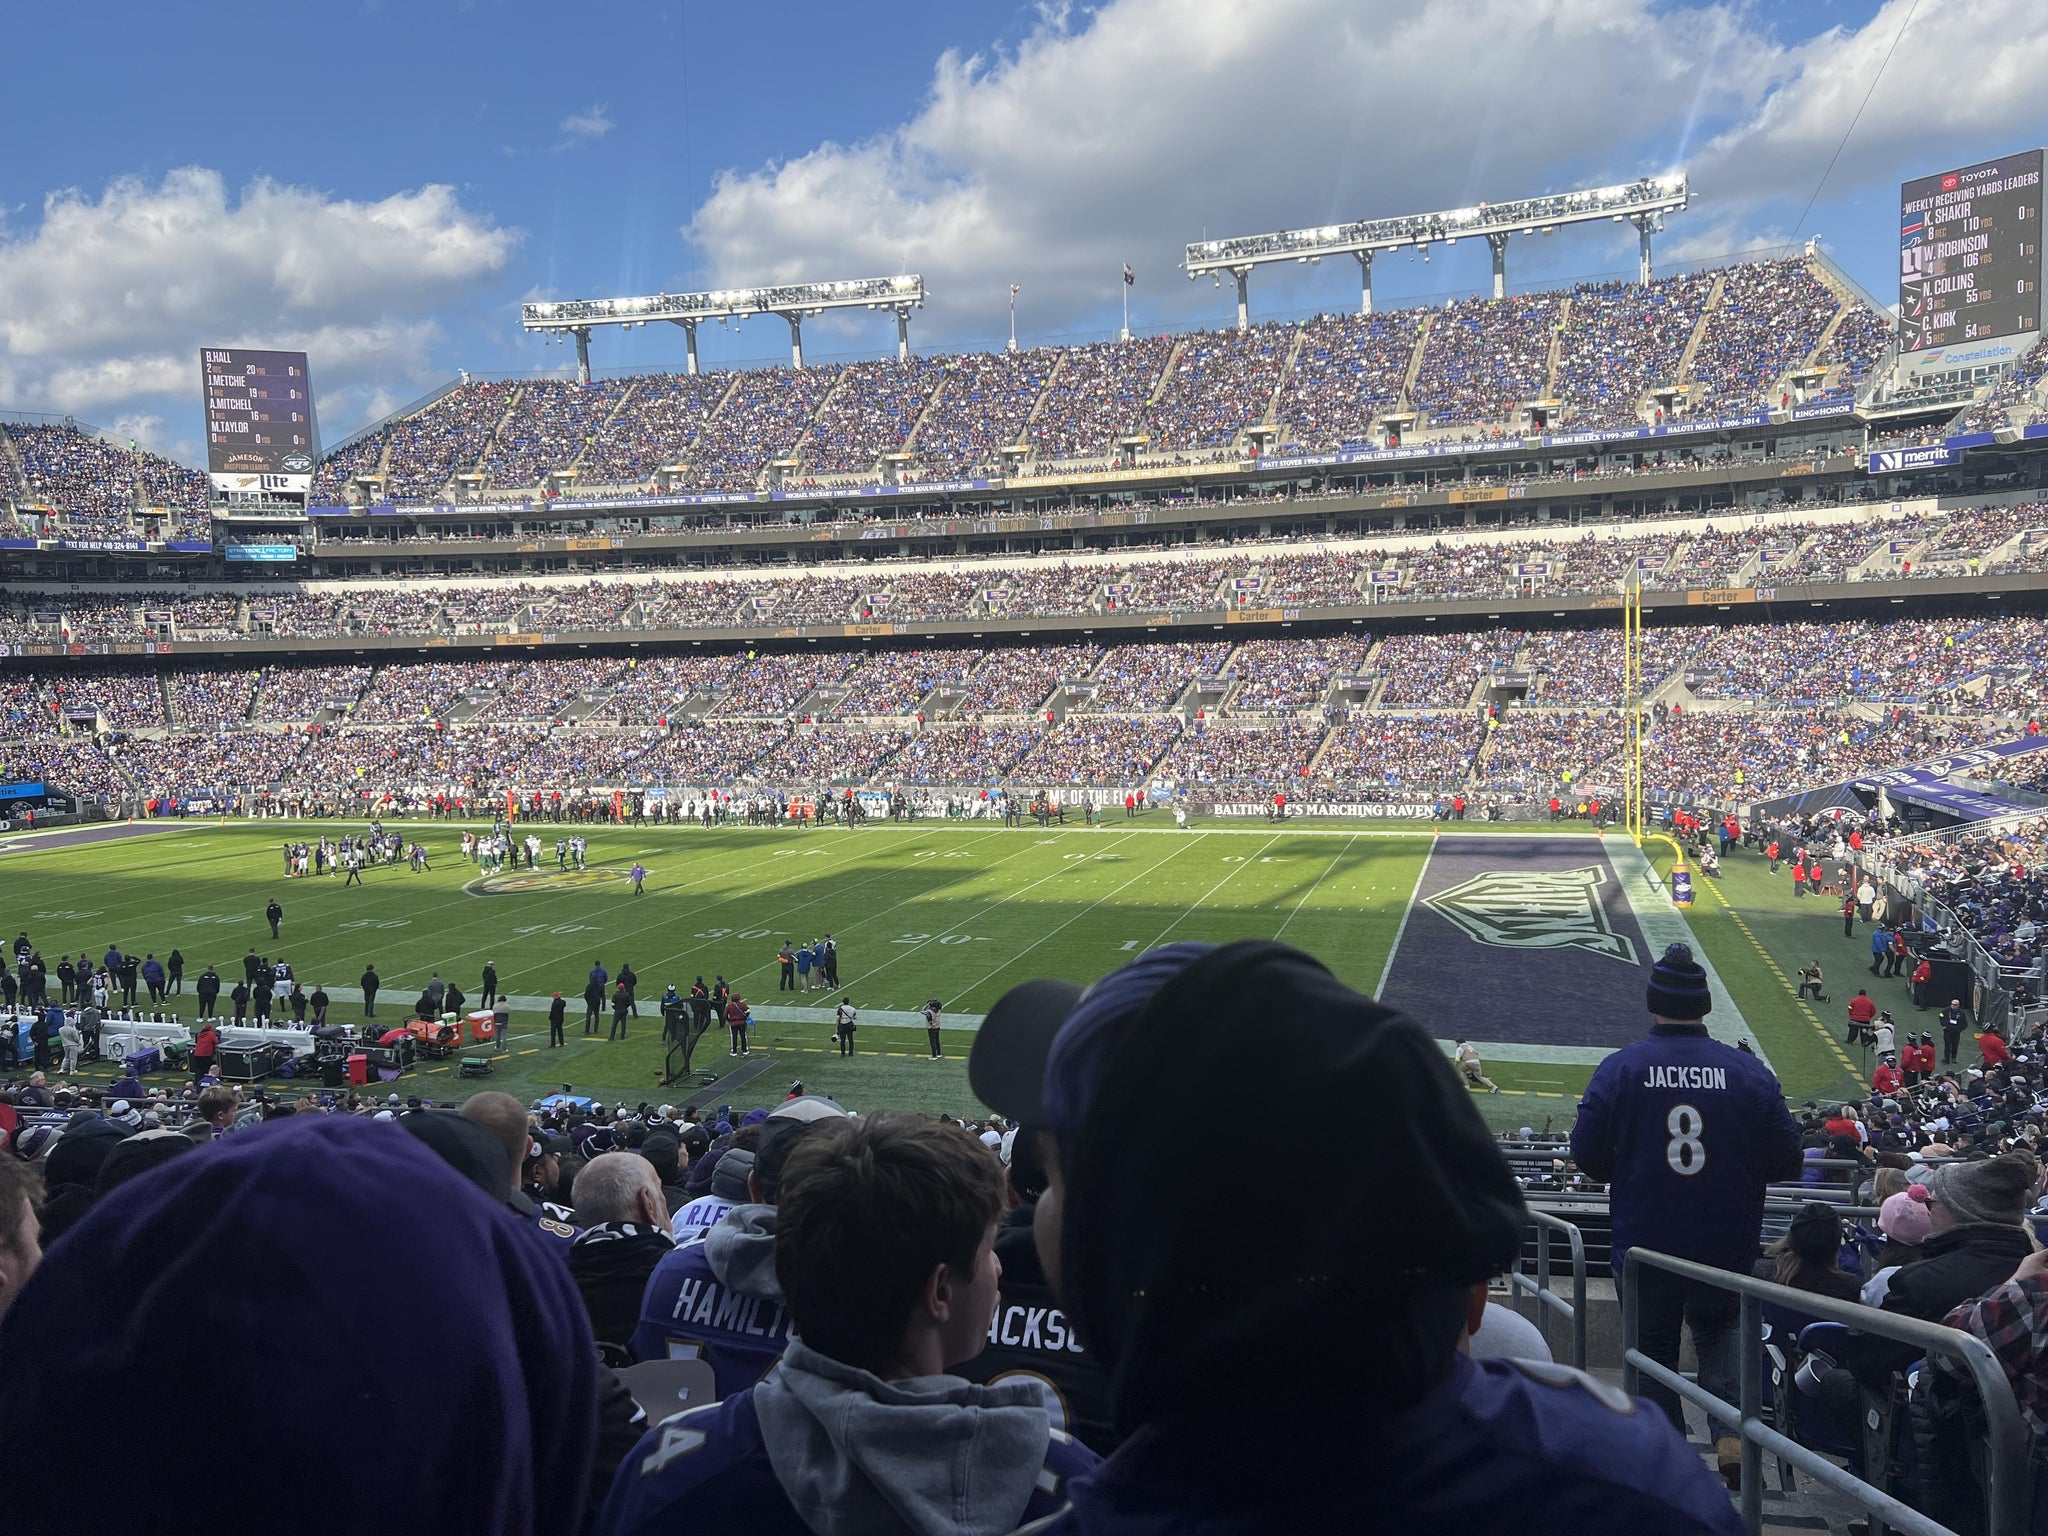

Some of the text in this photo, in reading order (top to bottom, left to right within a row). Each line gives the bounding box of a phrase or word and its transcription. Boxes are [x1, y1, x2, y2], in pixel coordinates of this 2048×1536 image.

[1961, 168, 1998, 183] TOYOTA
[1905, 172, 2039, 214] WEEKLY RECEIVING YARDS LEADERS
[1924, 202, 1971, 227] K. SHAKIR
[1928, 206, 2035, 240] 8 REC 110 YDS 0 TD
[1923, 233, 1988, 262] W. ROBINSON
[1928, 262, 1934, 275] 4
[1963, 253, 1979, 268] 106
[1980, 253, 1993, 265] YDS
[2019, 243, 2024, 257] 1
[2025, 245, 2034, 255] TD
[1923, 273, 1974, 298] N. COLLINS
[1927, 298, 1933, 311] 3
[1966, 289, 1979, 303] 55
[1979, 290, 1992, 301] YDS
[2018, 280, 2024, 294] 0
[2025, 282, 2034, 292] TD
[1923, 311, 1957, 331] C. KIRK
[1927, 332, 1933, 345] 5
[1966, 324, 1977, 338] 54
[1978, 325, 1991, 336] YDS
[2018, 316, 2023, 329] 1
[2024, 318, 2033, 328] TD
[206, 351, 232, 364] B.HALL
[1945, 346, 2012, 364] Constellation
[207, 363, 294, 377] 2 20 0
[208, 375, 246, 387] J.METCHIE
[210, 387, 296, 399] 1 19 0
[210, 398, 253, 411] A.MITCHELL
[1796, 404, 1851, 419] RING HONOR
[212, 410, 297, 422] 1 16 0
[211, 422, 249, 434] M.TAYLOR
[1667, 418, 1760, 435] HALOTI NGATA 2006-2014
[212, 433, 299, 445] 0 0 0
[1552, 430, 1639, 445] BRIAN BILLICK 1999-2007
[228, 454, 264, 463] JAMESON
[1262, 442, 1520, 469] MATT STOVER 1996-2008 JAMAL LEWIS 2000-2006 TODD HEAP 2001-2010
[1905, 448, 1950, 462] merritt
[260, 475, 289, 491] Lite
[1013, 479, 1042, 487] JONATHAN
[1043, 477, 1064, 486] OGDEN
[1118, 472, 1136, 480] LEWIS
[1137, 470, 1169, 478] 1996-2012
[1188, 467, 1206, 475] REED
[1462, 488, 1526, 502] Carter CAT
[1135, 513, 1148, 524] 1:37
[891, 527, 896, 538] 0
[989, 521, 997, 533] 10
[576, 540, 625, 549] Carter CAT
[1703, 588, 1776, 603] Carter CAT
[1239, 609, 1301, 622] Carter CAT
[856, 624, 908, 635] Carter CAT
[507, 634, 557, 644] Carter CAT
[14, 645, 67, 656] 14 7
[103, 643, 155, 654] 0 10
[1071, 789, 1084, 805] OF
[1088, 790, 1109, 805] THE
[1307, 804, 1383, 816] MARCHING
[1387, 805, 1434, 817] RAVEN
[694, 929, 772, 940] 30
[891, 934, 972, 945] 20
[481, 1020, 492, 1032] G
[1644, 1066, 1728, 1090] JACKSON
[1666, 1104, 1708, 1166] 8
[686, 1205, 733, 1226] R.LE
[539, 1217, 575, 1238] 8
[640, 1427, 706, 1477] 4
